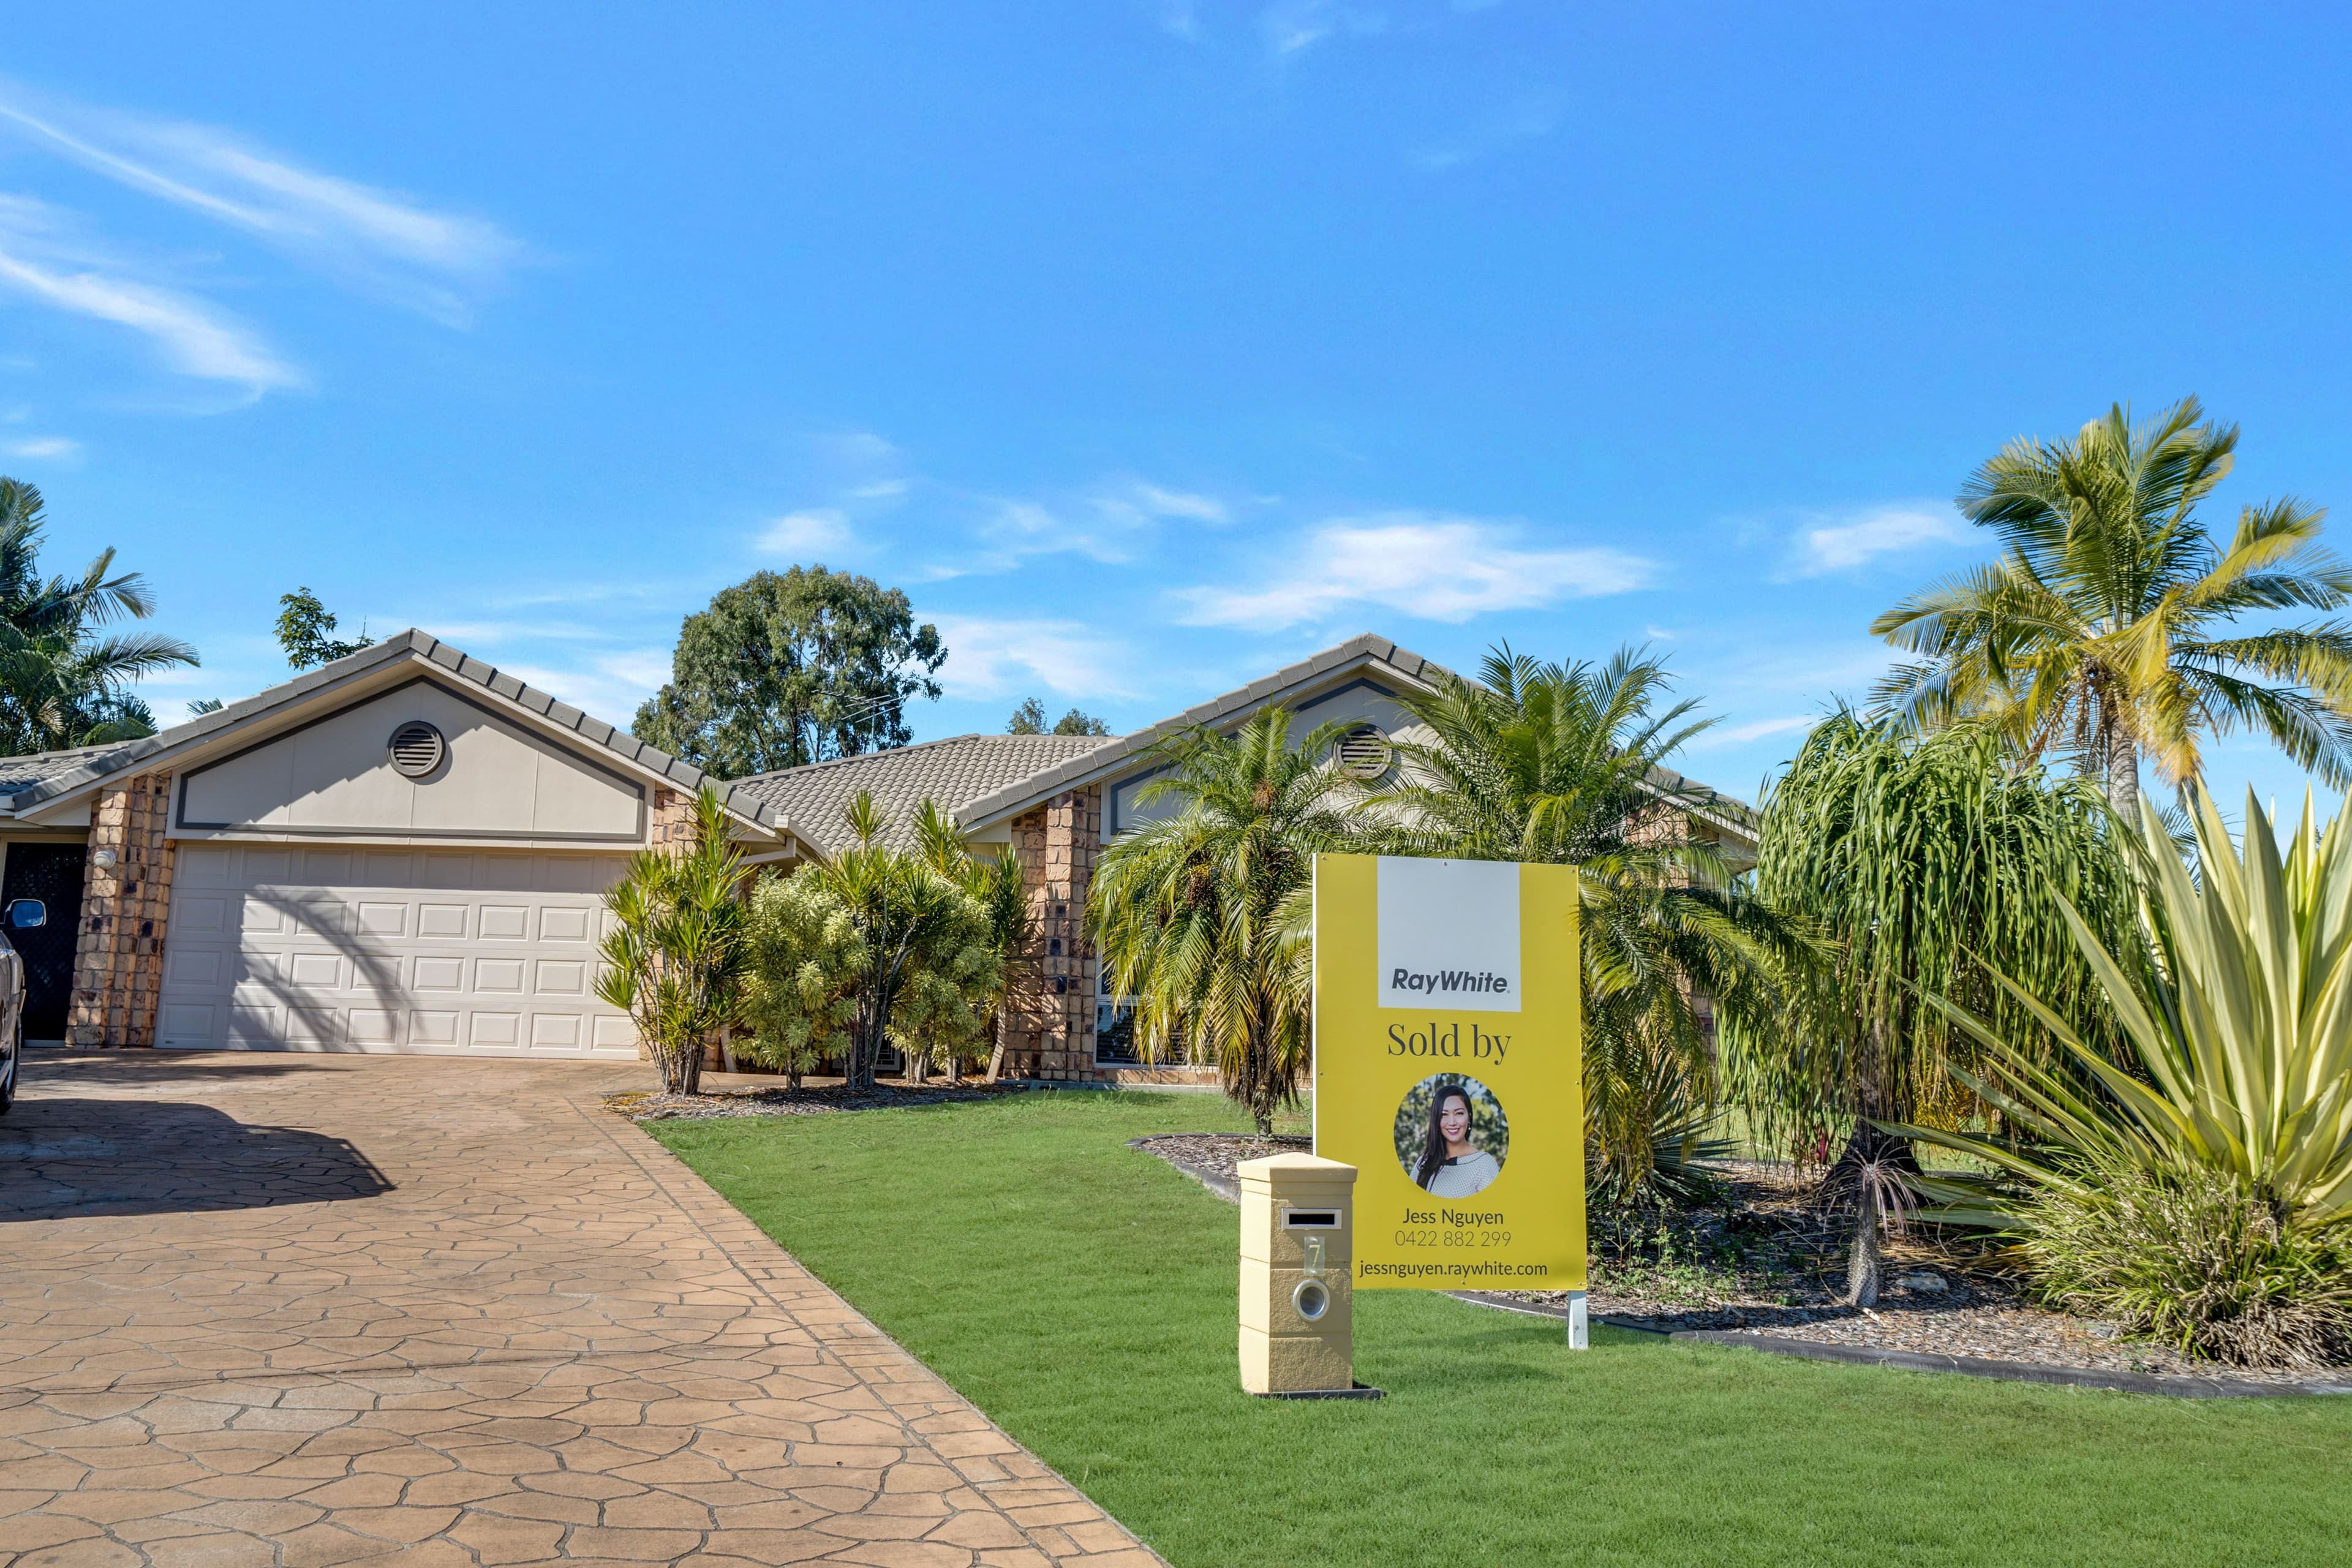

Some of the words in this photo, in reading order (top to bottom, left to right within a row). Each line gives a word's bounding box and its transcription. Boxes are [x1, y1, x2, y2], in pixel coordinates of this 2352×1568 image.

[1388, 1022, 1461, 1057] Sold
[1471, 1023, 1512, 1066] by
[1403, 1208, 1436, 1224] Jess
[1442, 1208, 1504, 1227] Nguyen
[1395, 1230, 1438, 1246] 0422
[1443, 1231, 1474, 1246] 882
[1480, 1231, 1511, 1247] 299
[1308, 1244, 1321, 1268] 7
[1359, 1260, 1548, 1278] jessnguyen.raywhite.com
